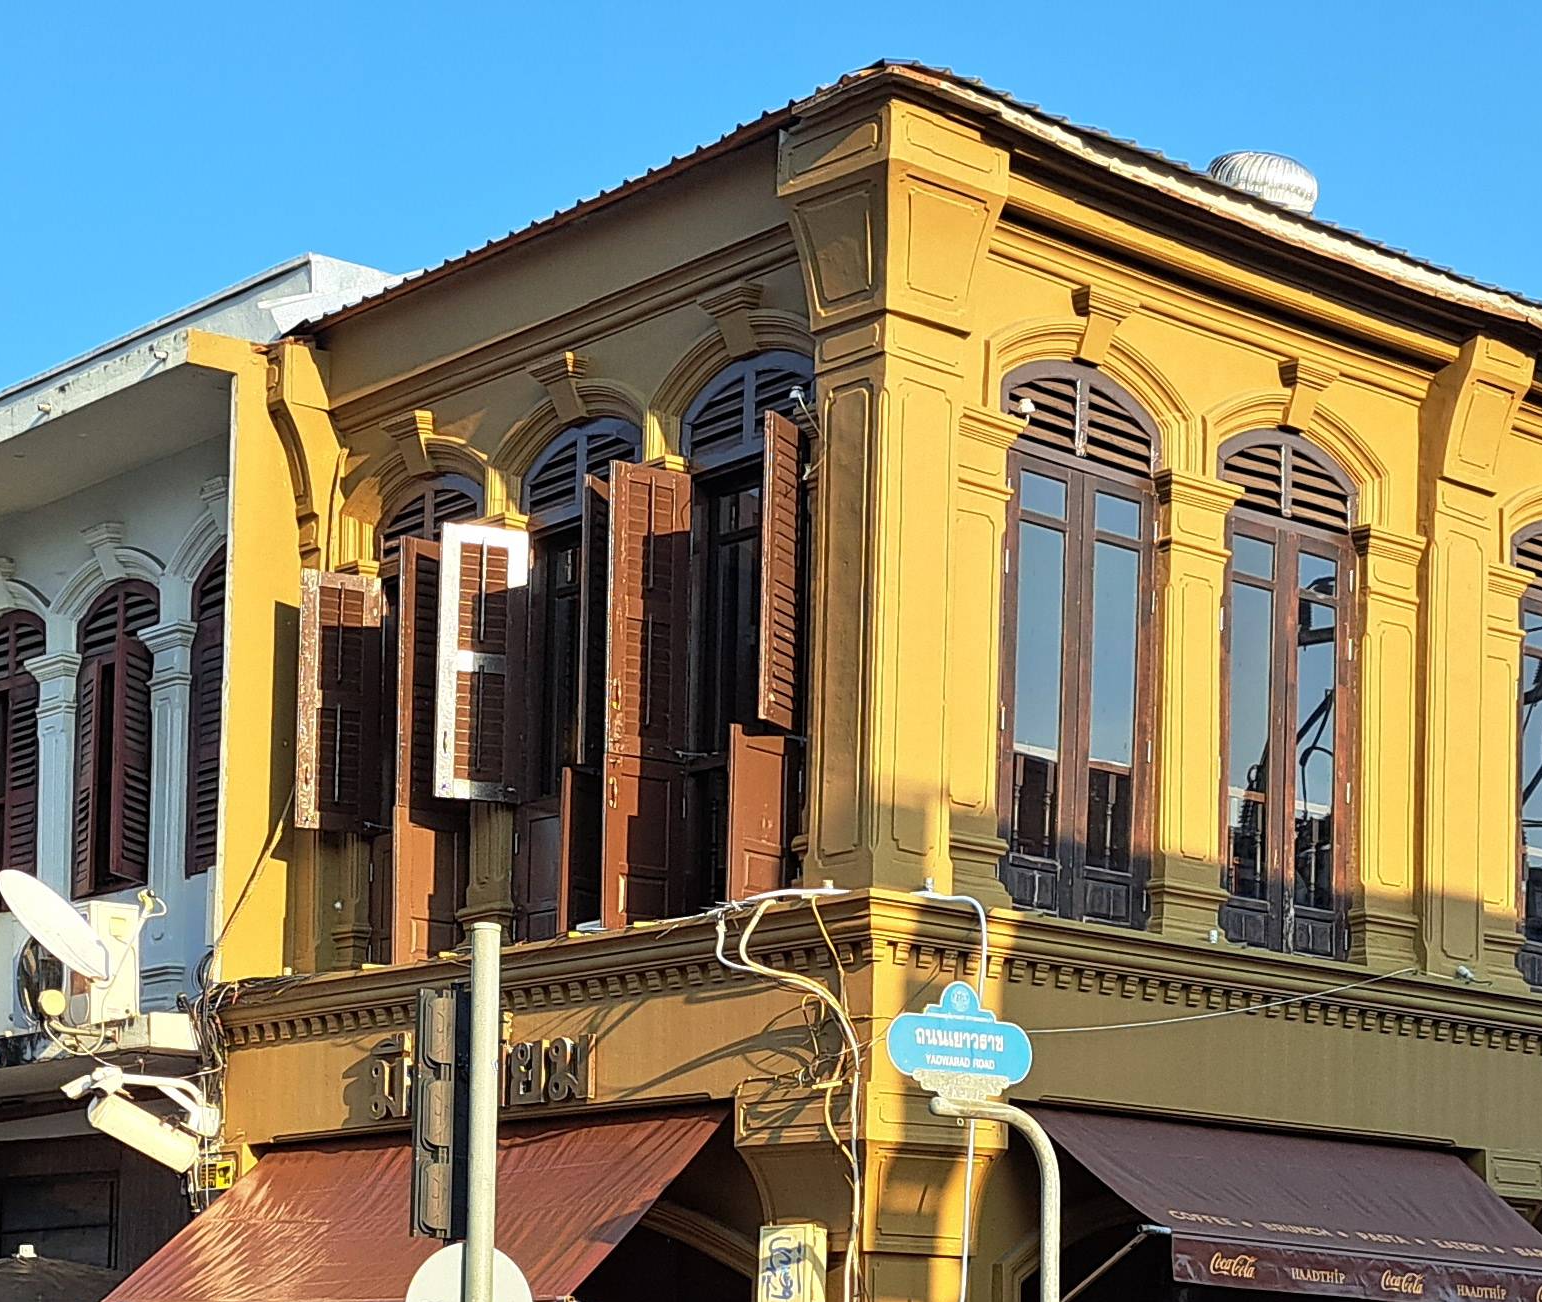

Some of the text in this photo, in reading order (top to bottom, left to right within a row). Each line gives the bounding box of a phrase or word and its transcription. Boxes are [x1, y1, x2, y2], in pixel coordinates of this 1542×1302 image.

[925, 1053, 995, 1070] YAOWARAD ROAD
[1168, 1209, 1237, 1227] COFFEE
[1259, 1221, 1334, 1237] BRUNCH
[1355, 1231, 1411, 1245] PASTA
[1431, 1238, 1491, 1253] EATERY
[1210, 1252, 1258, 1279] Coca-Cola
[1381, 1268, 1426, 1295] Coca-Cola
